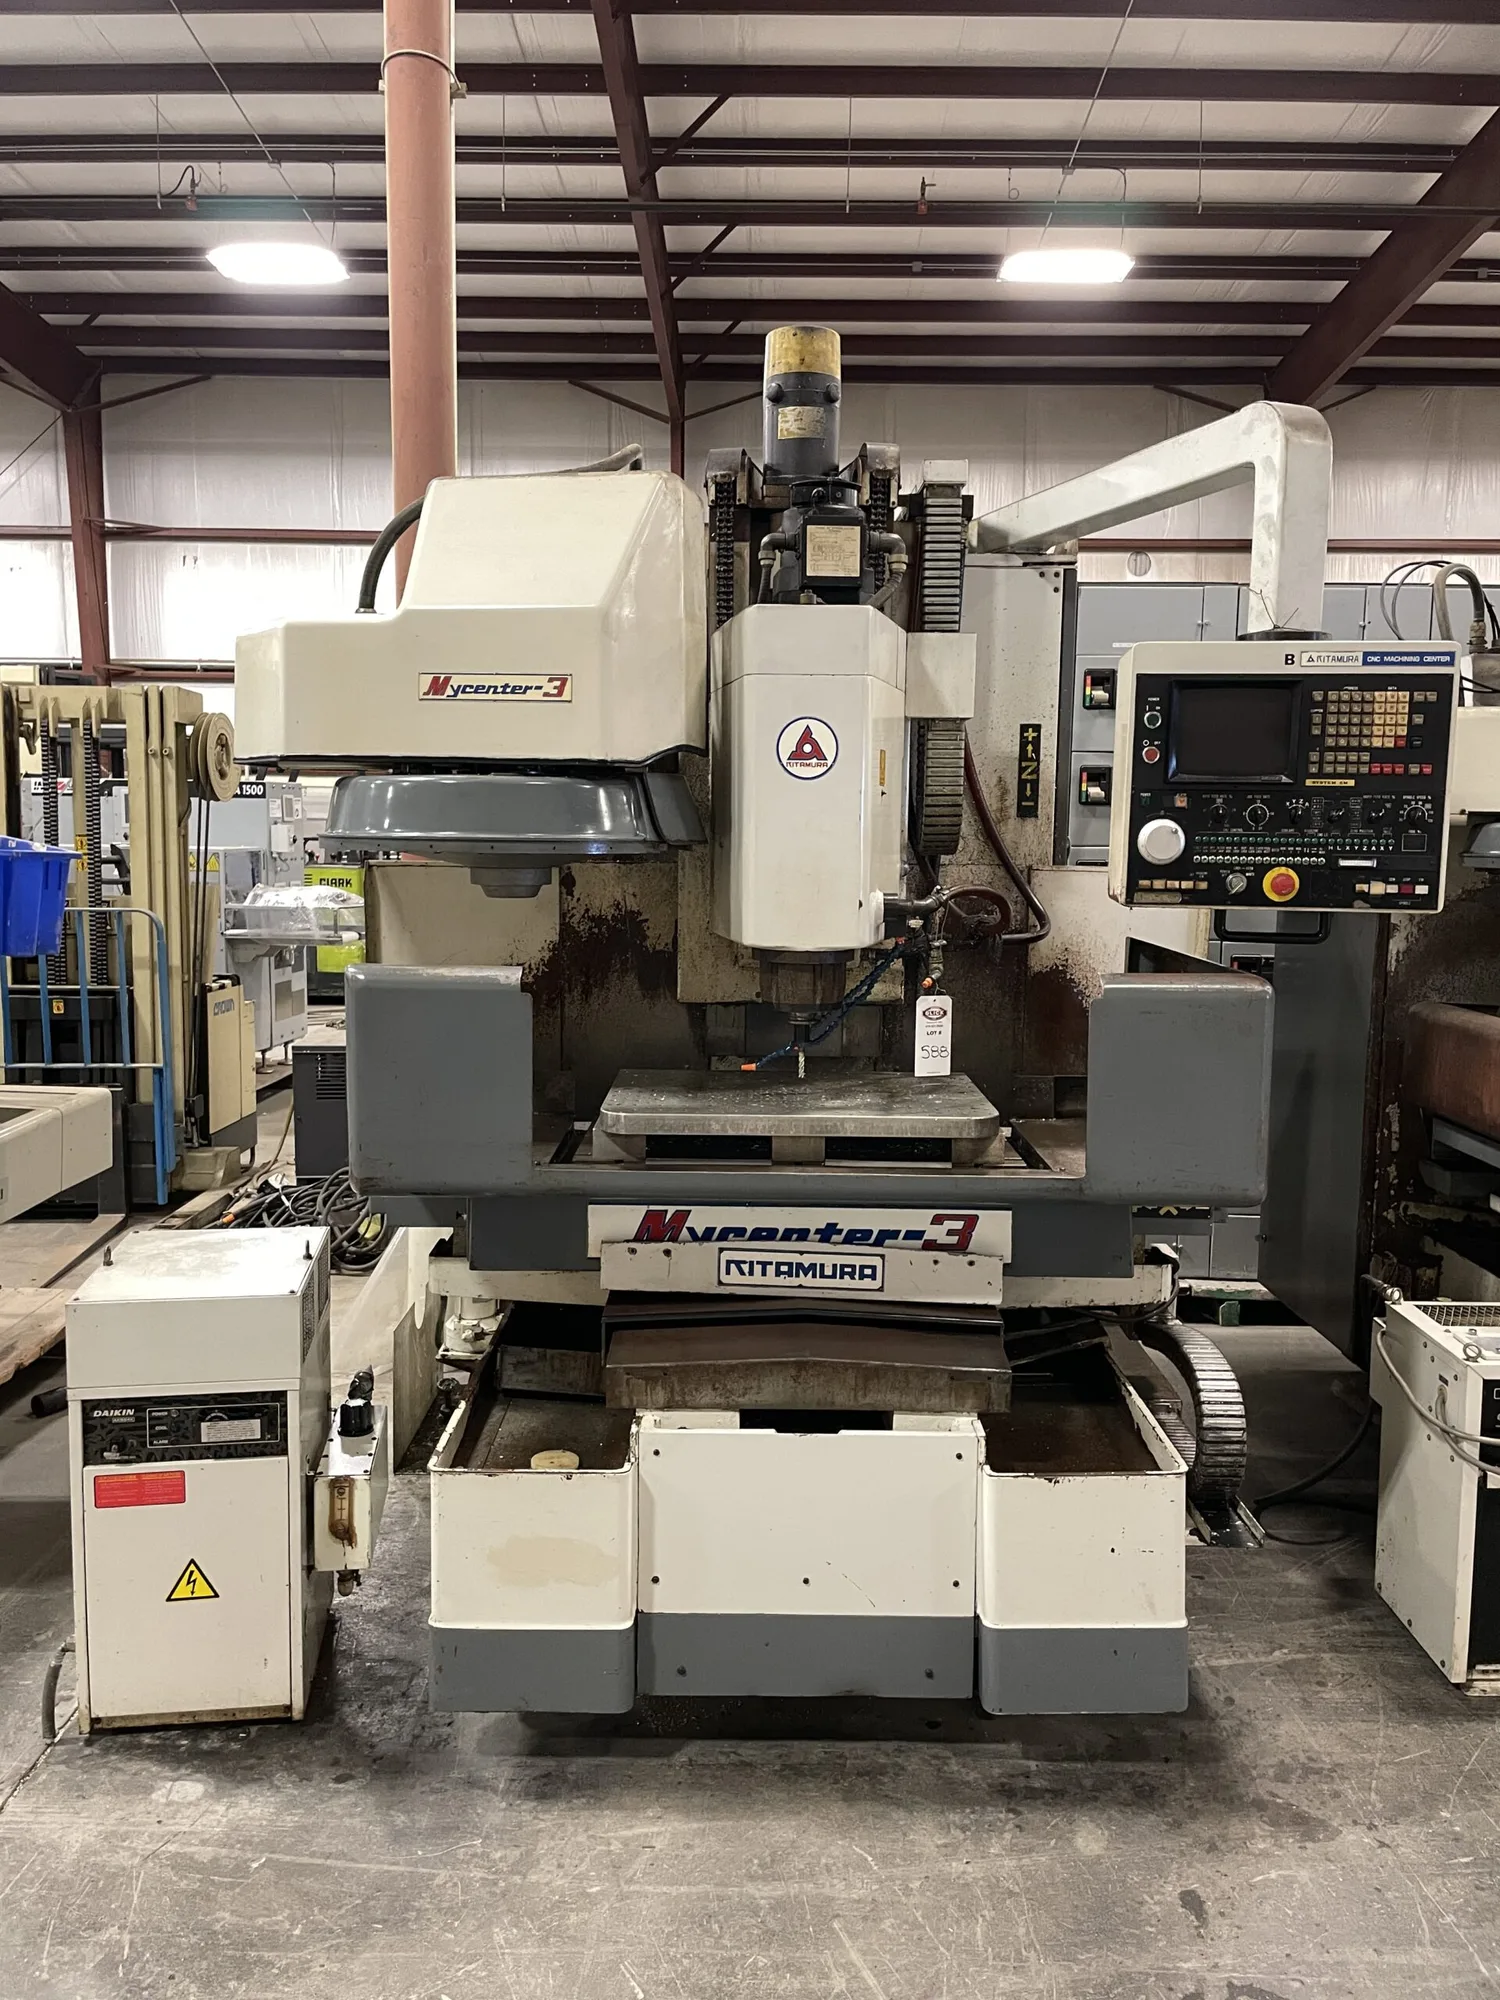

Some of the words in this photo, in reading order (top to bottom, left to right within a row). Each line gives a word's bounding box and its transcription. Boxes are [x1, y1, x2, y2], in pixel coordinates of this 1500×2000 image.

[1284, 654, 1296, 666] B
[1317, 655, 1360, 664] KITAMURA
[1367, 655, 1381, 663] CNC
[1384, 655, 1420, 663] MACHINING
[1423, 655, 1451, 663] CENTER
[423, 675, 569, 698] Mycenter-3
[242, 784, 264, 795] 1500
[921, 1045, 950, 1059] 588
[624, 1209, 979, 1251] Mycenter-3
[725, 1259, 877, 1281] KITAMURA
[93, 1408, 135, 1417] DAIKIN
